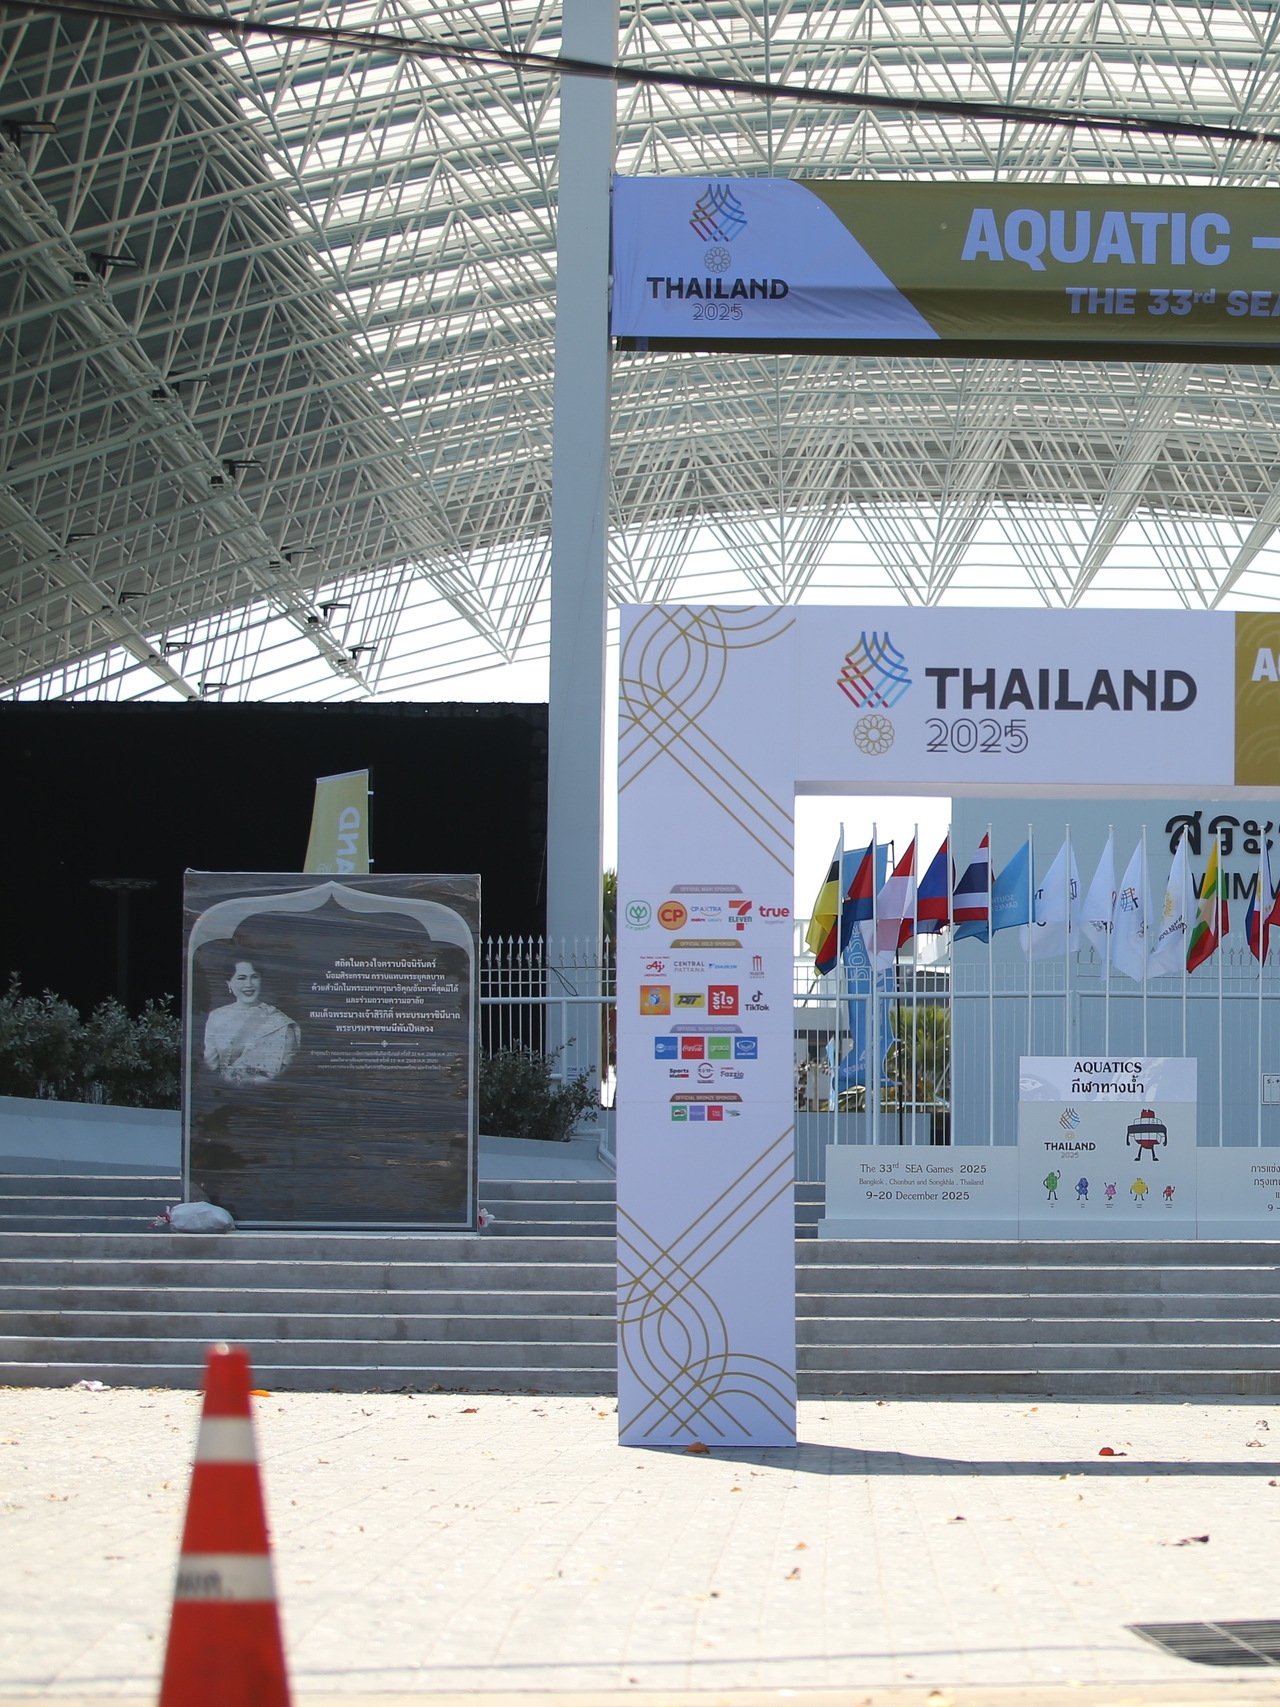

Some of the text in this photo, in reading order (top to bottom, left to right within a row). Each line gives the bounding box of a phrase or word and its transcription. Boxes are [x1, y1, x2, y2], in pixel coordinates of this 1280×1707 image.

[961, 208, 1231, 271] AQUATIC
[1252, 236, 1280, 249] -
[646, 277, 789, 300] THAILAND
[1065, 287, 1137, 315] THE
[1147, 288, 1216, 316] 33rd
[692, 303, 743, 321] 2025
[925, 667, 1197, 712] THAILAND
[925, 718, 1028, 753] 2025
[661, 909, 684, 922] CP
[759, 906, 790, 918] true
[745, 1004, 770, 1012] TikTok
[1073, 1061, 1142, 1074] AQUATICS
[1071, 1075, 1144, 1094] กีฬาทางน้ำ
[1044, 1142, 1096, 1151] THAILAND
[860, 1162, 987, 1174] The 33rd SEA Games 2025
[889, 1178, 915, 1186] Chonburi
[917, 1178, 927, 1186] and
[960, 1178, 984, 1186] Thailand
[865, 1190, 970, 1201] 9-20 December 2025
[1267, 1204, 1274, 1212] 9
